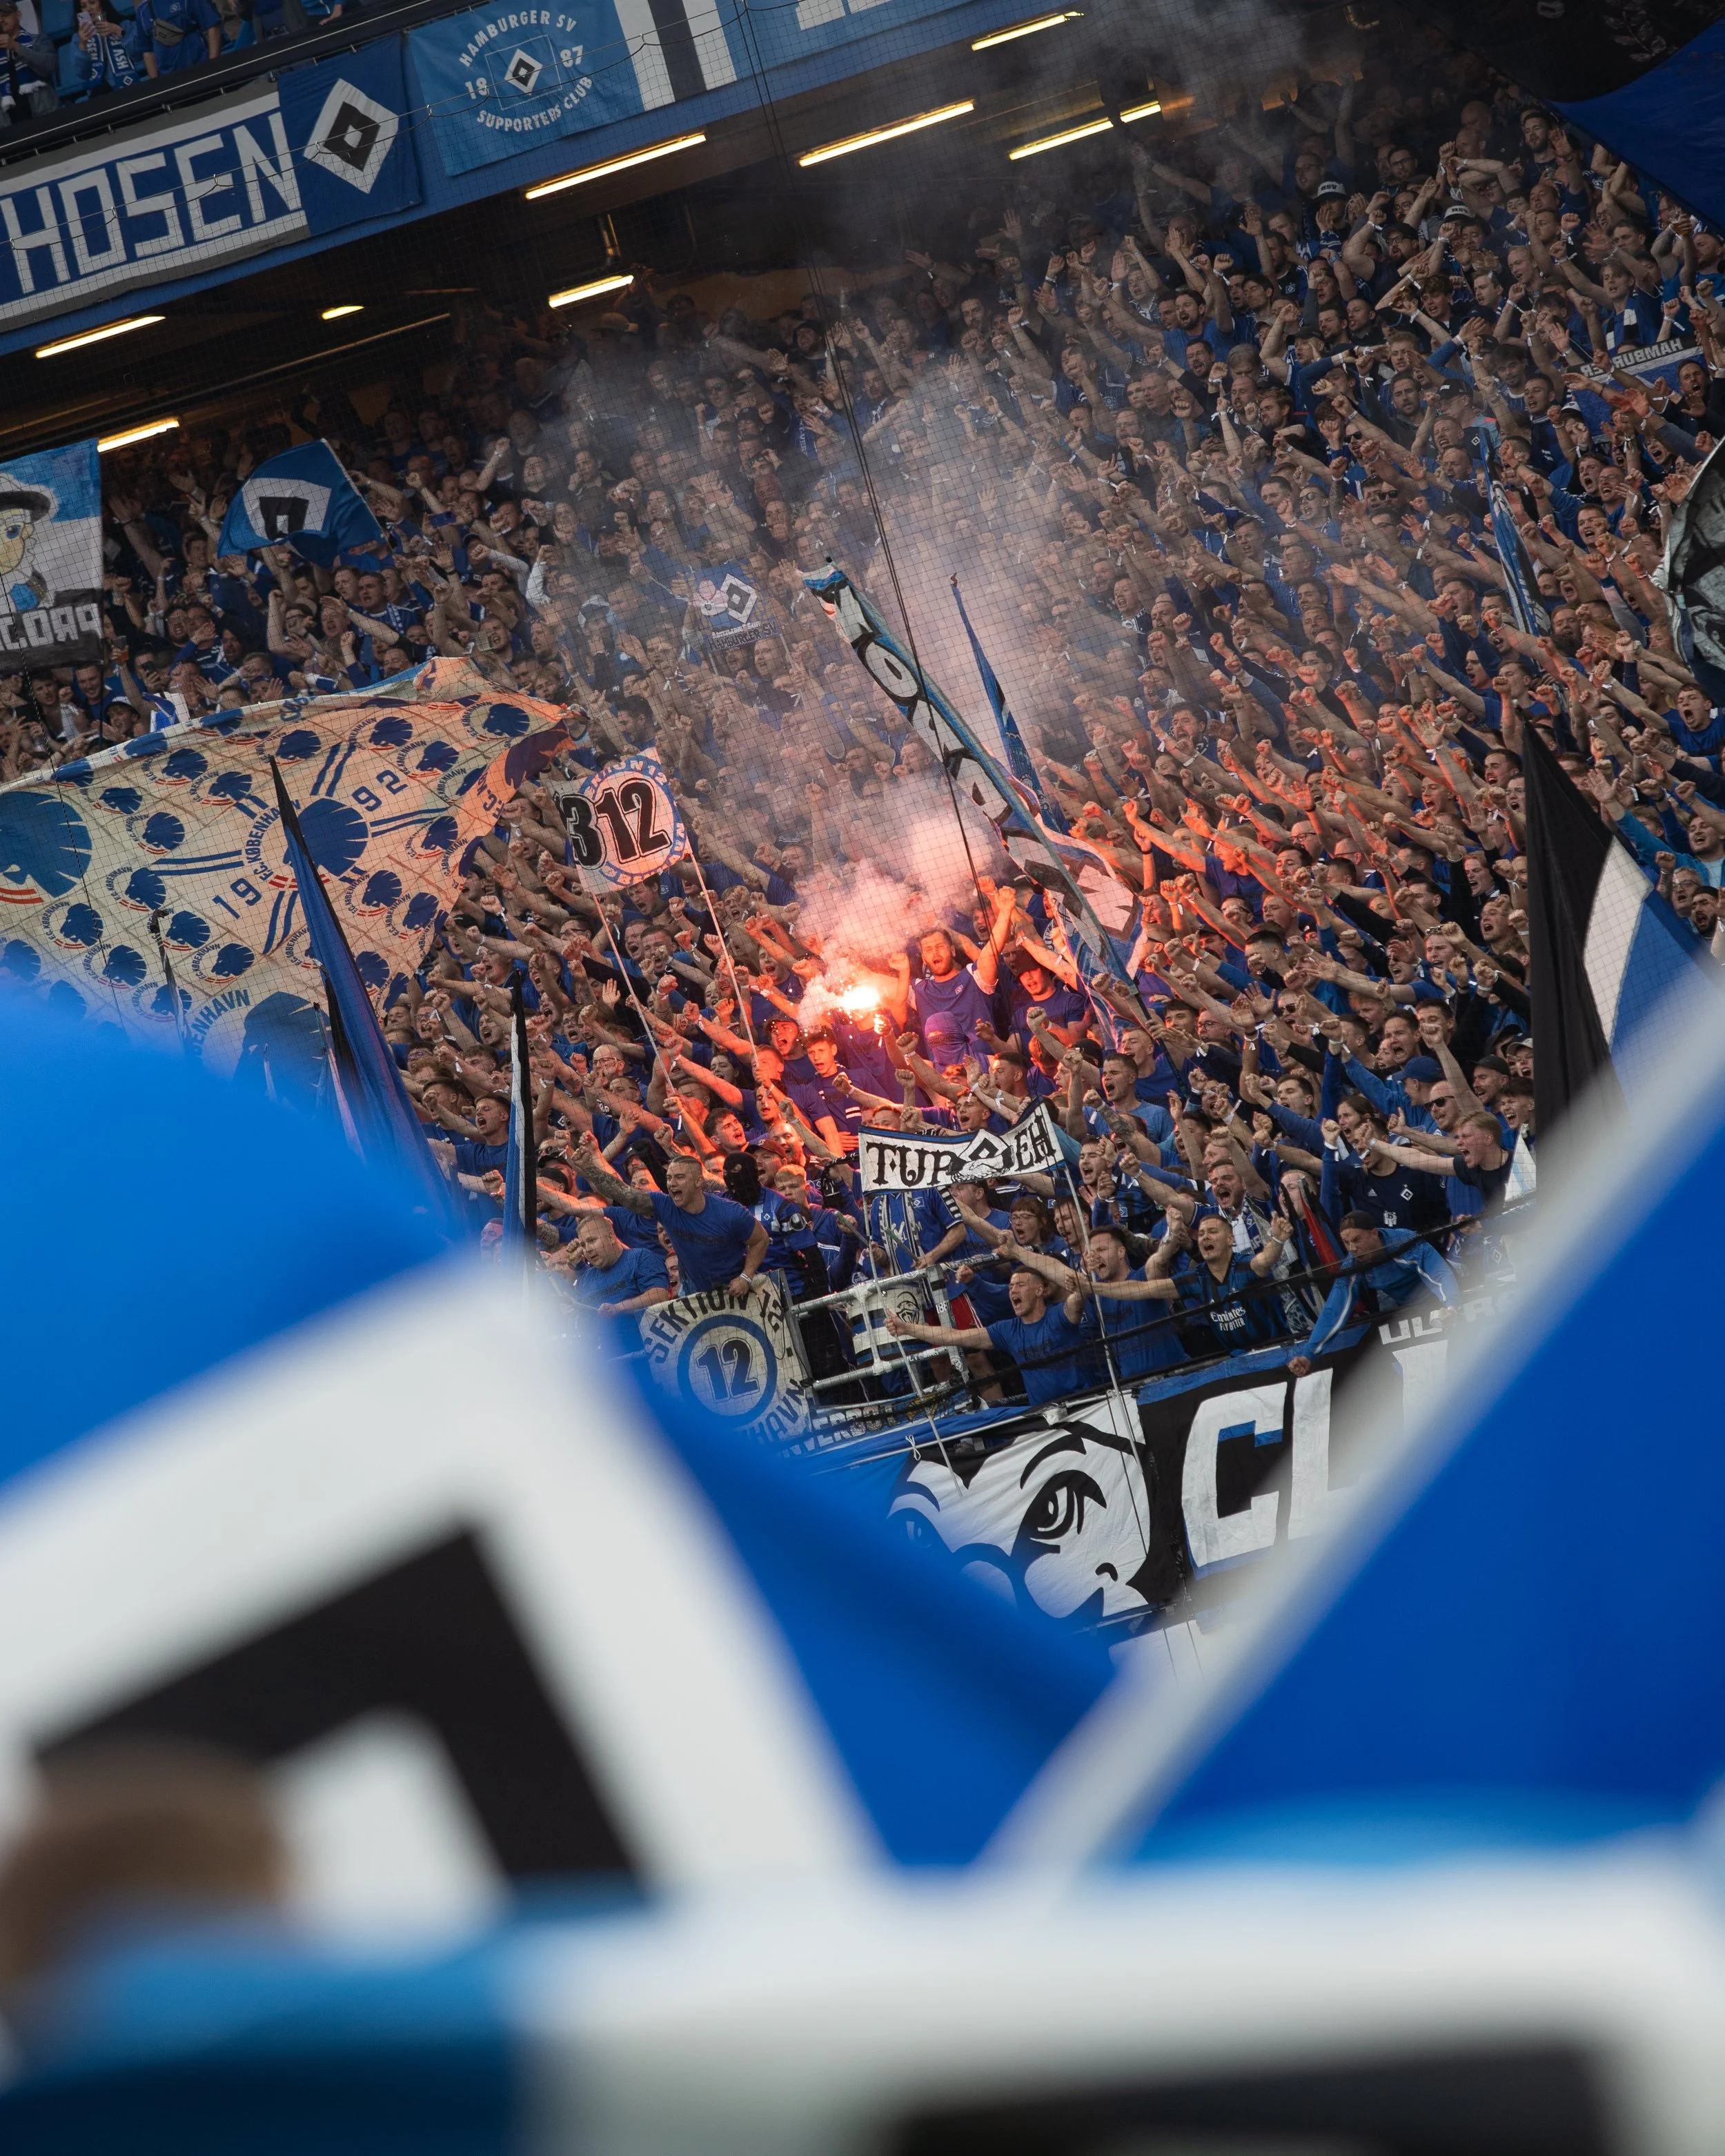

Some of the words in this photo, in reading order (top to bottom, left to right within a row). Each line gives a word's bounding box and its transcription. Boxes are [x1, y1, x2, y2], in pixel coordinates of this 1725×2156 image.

[112, 49, 129, 70] HSV
[458, 10, 551, 67] HAMBURGER
[555, 14, 577, 32] SV
[464, 77, 489, 99] 18
[560, 45, 584, 68] 87
[476, 104, 562, 132] SUPPORTERS
[564, 77, 593, 110] CLUB
[245, 798, 302, 863] KØBENHAN
[643, 1288, 751, 1364] SEKTION
[1210, 1307, 1246, 1323] Emiates
[1219, 1322, 1229, 1332] FLY
[1228, 1317, 1246, 1332] BTTER
[696, 1337, 760, 1403] 12
